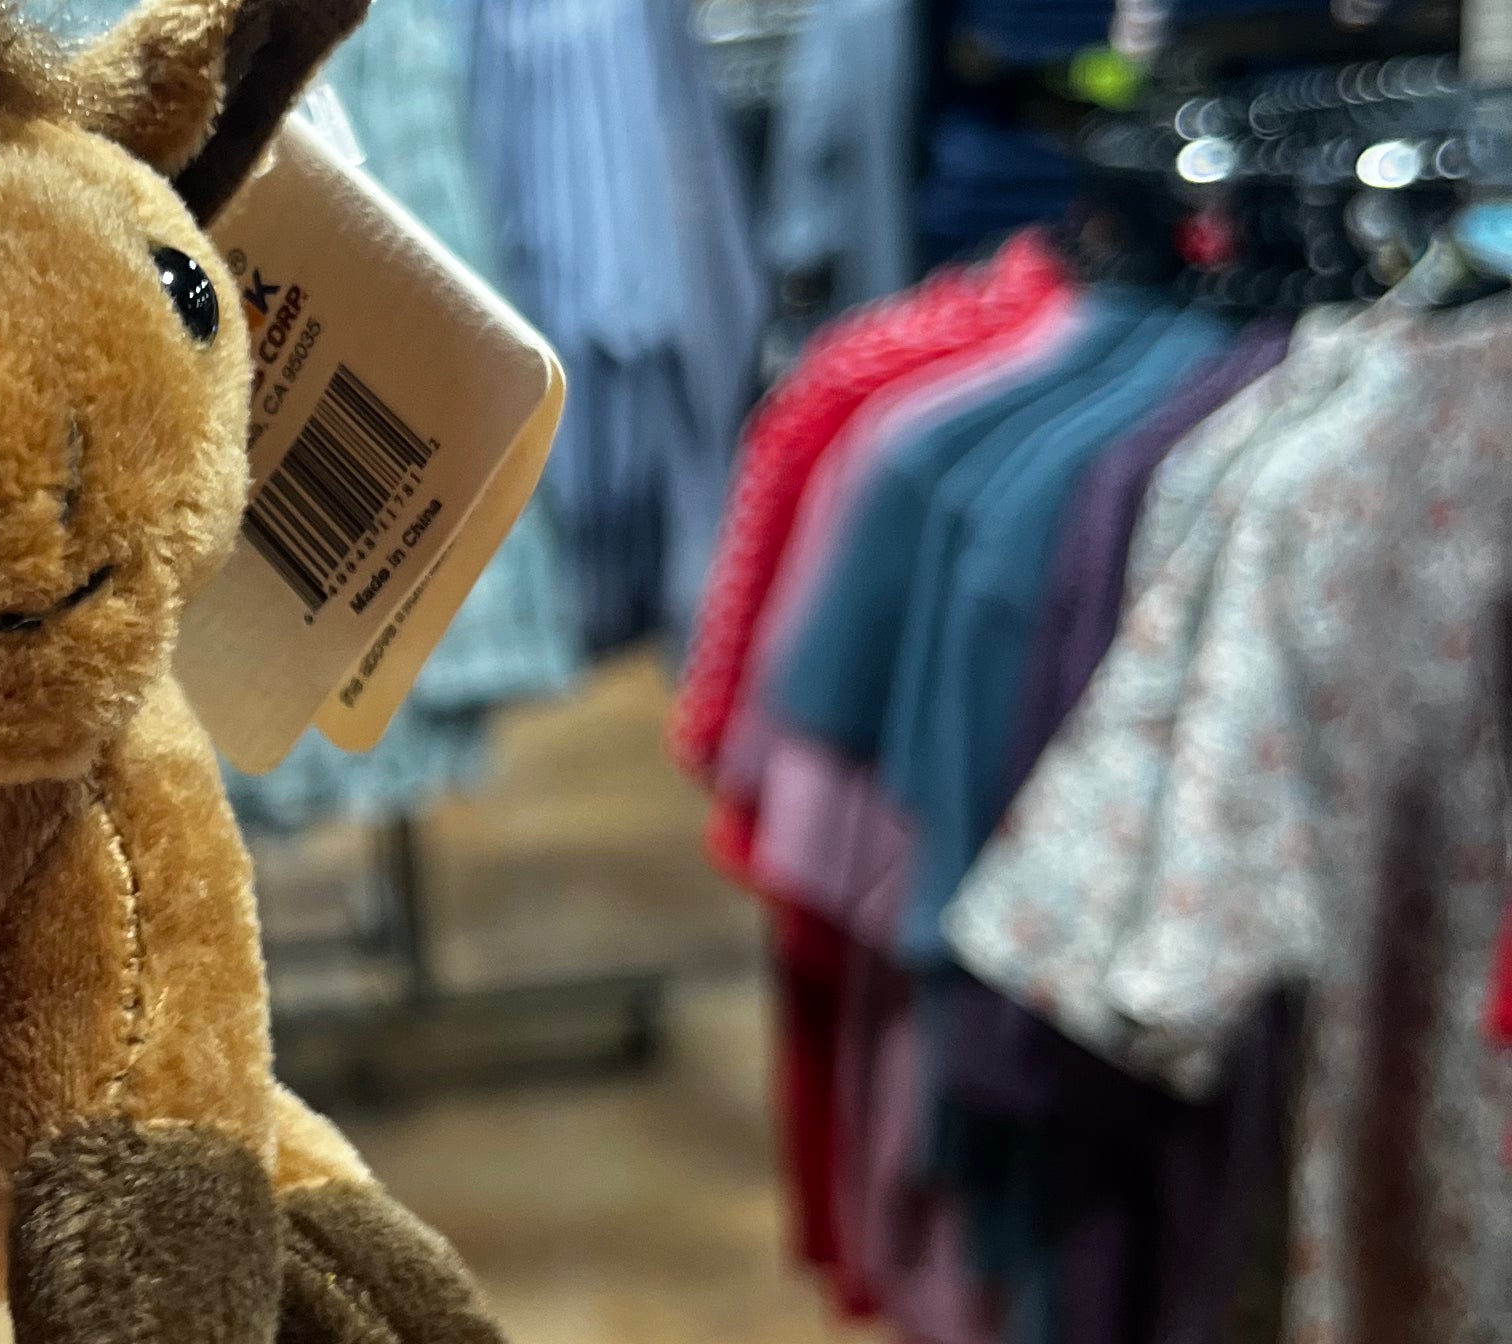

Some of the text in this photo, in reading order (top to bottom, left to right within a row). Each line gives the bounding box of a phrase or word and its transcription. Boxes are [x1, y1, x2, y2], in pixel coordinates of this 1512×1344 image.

[259, 284, 308, 364] CORP.
[263, 317, 321, 415] CA 95035
[428, 436, 441, 453] 2
[349, 567, 391, 615] Made
[387, 547, 406, 568] in
[402, 498, 443, 548] China
